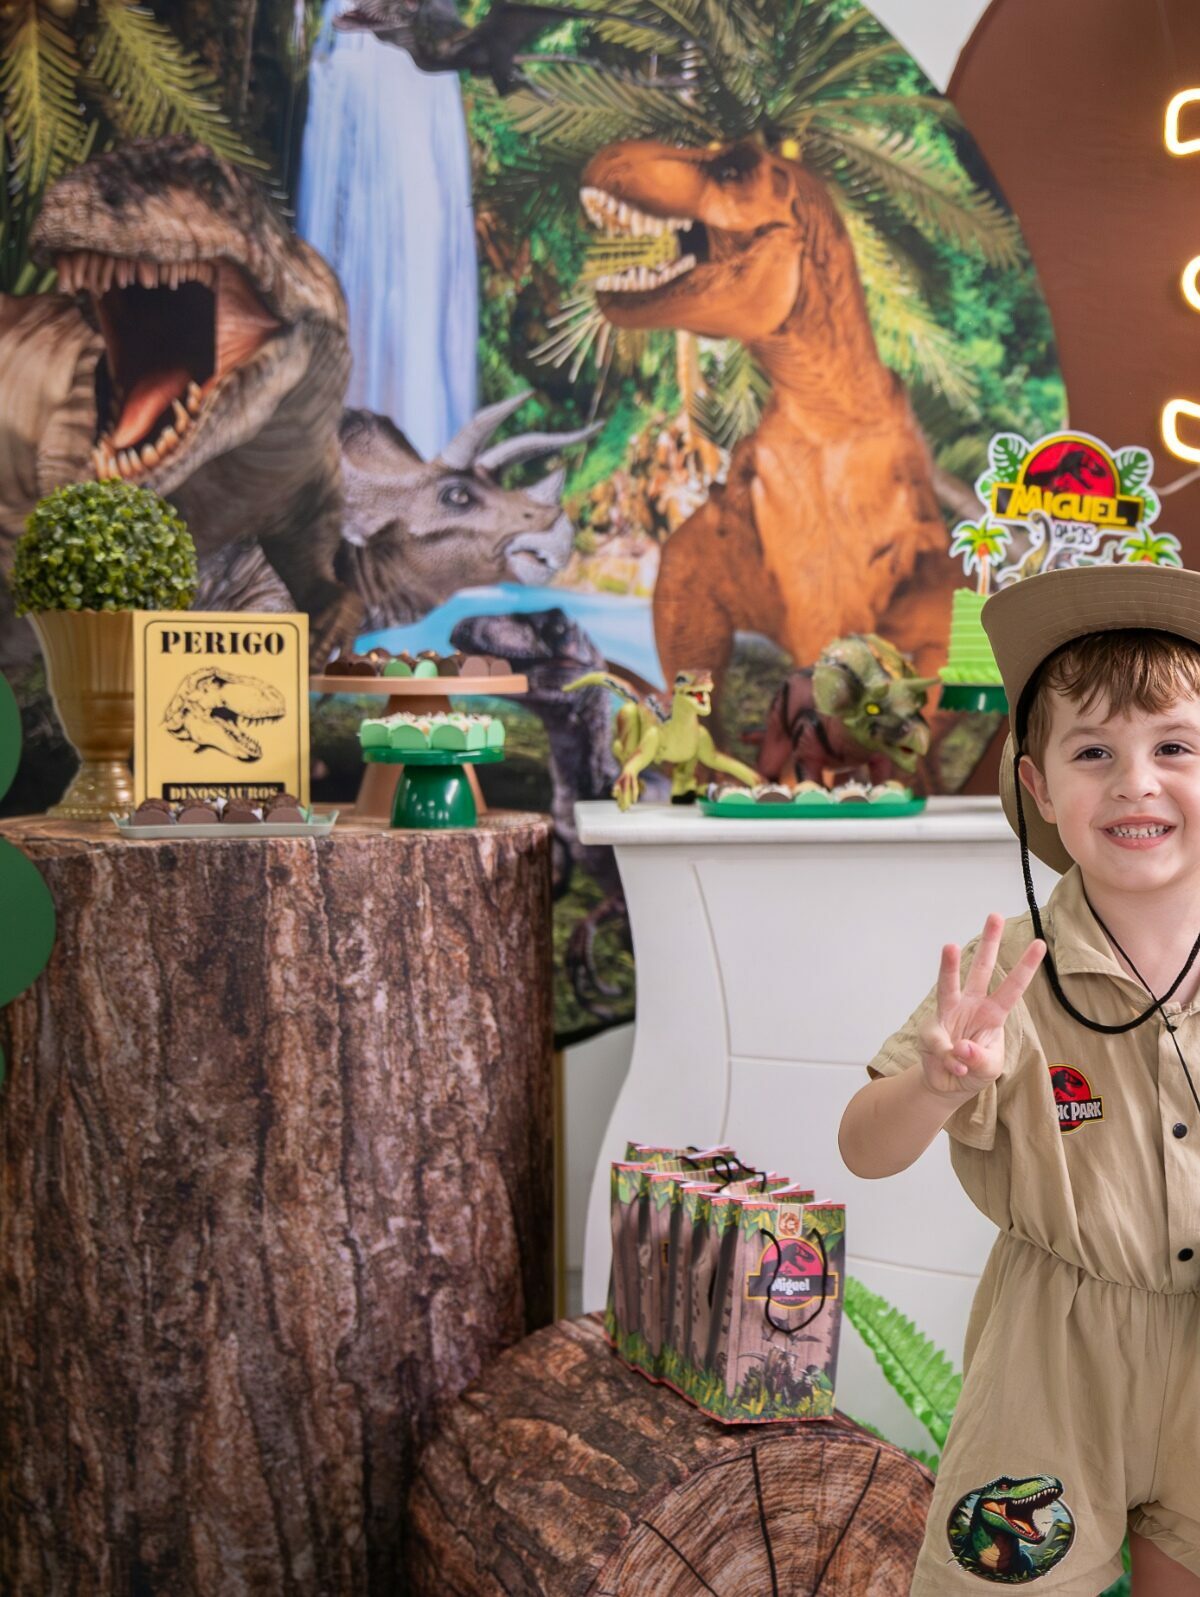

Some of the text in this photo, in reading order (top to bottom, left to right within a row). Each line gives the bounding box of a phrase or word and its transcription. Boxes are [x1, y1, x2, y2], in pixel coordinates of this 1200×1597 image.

[1006, 485, 1127, 524] MIGUEL
[161, 631, 285, 656] PERIGO
[1070, 1102, 1102, 1121] PARK
[771, 1277, 811, 1296] Miguel
